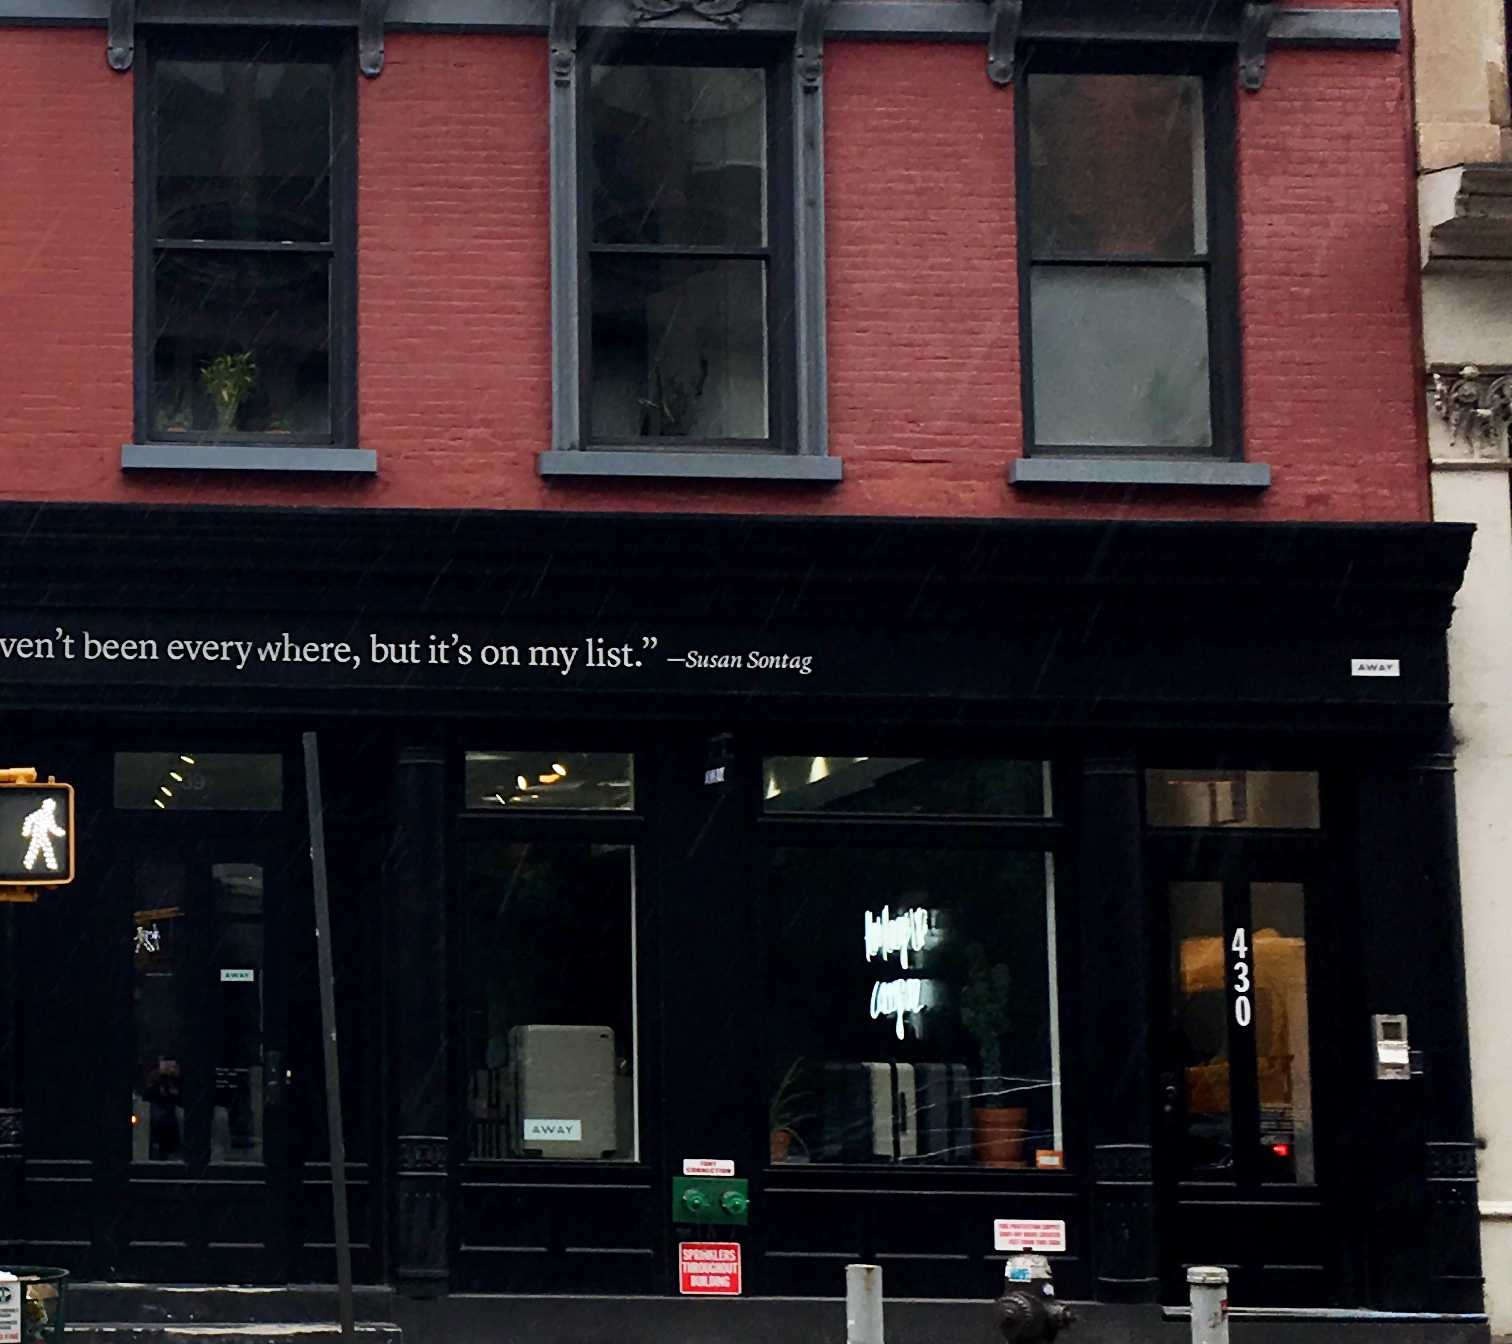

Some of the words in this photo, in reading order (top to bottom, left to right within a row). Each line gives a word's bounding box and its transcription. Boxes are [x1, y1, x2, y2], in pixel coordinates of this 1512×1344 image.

[83, 631, 159, 660] been
[370, 634, 421, 664] but
[428, 633, 473, 665] it’s
[480, 645, 521, 666] on
[528, 646, 579, 675] my
[746, 650, 813, 675] Sontag
[1357, 663, 1393, 671] AWAY
[1231, 927, 1252, 1027] 430
[532, 1125, 573, 1134] AWAY
